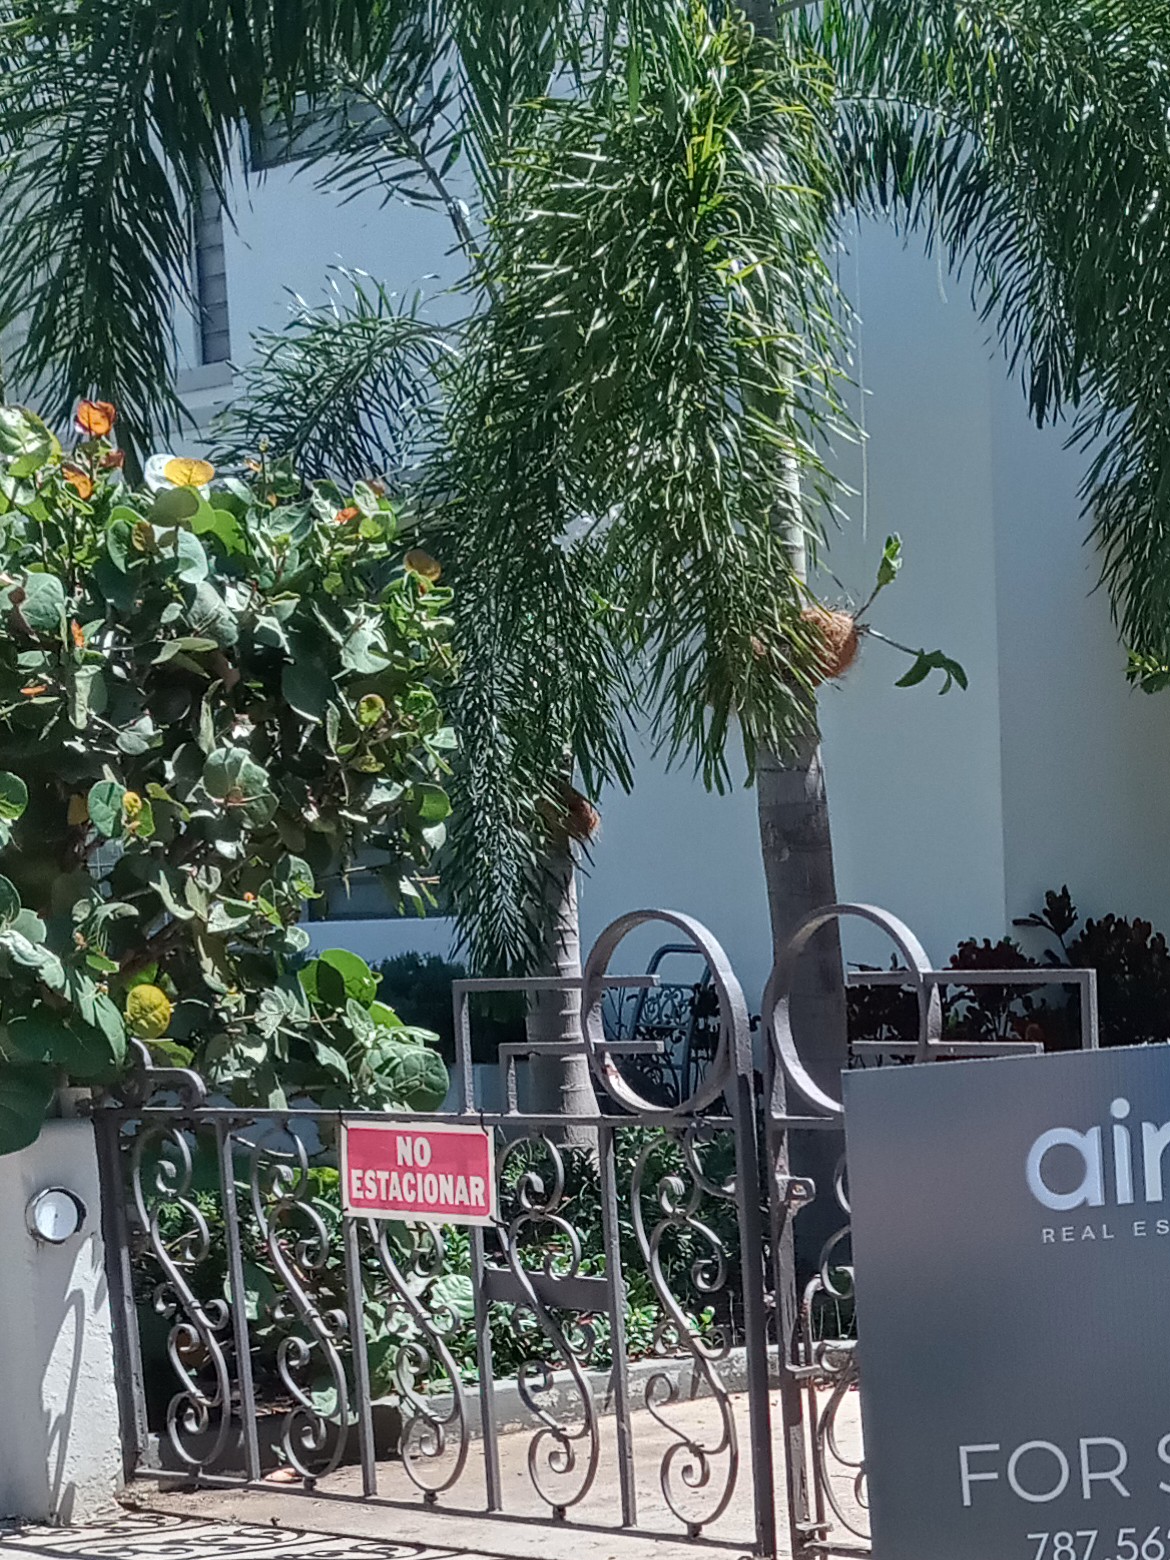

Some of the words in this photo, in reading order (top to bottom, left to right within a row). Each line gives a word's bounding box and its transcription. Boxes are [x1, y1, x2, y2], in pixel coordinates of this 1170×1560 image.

[396, 1136, 432, 1167] NO
[351, 1169, 486, 1207] ESTACIONAR
[1042, 1224, 1115, 1244] REAL
[958, 1436, 1131, 1507] FOR
